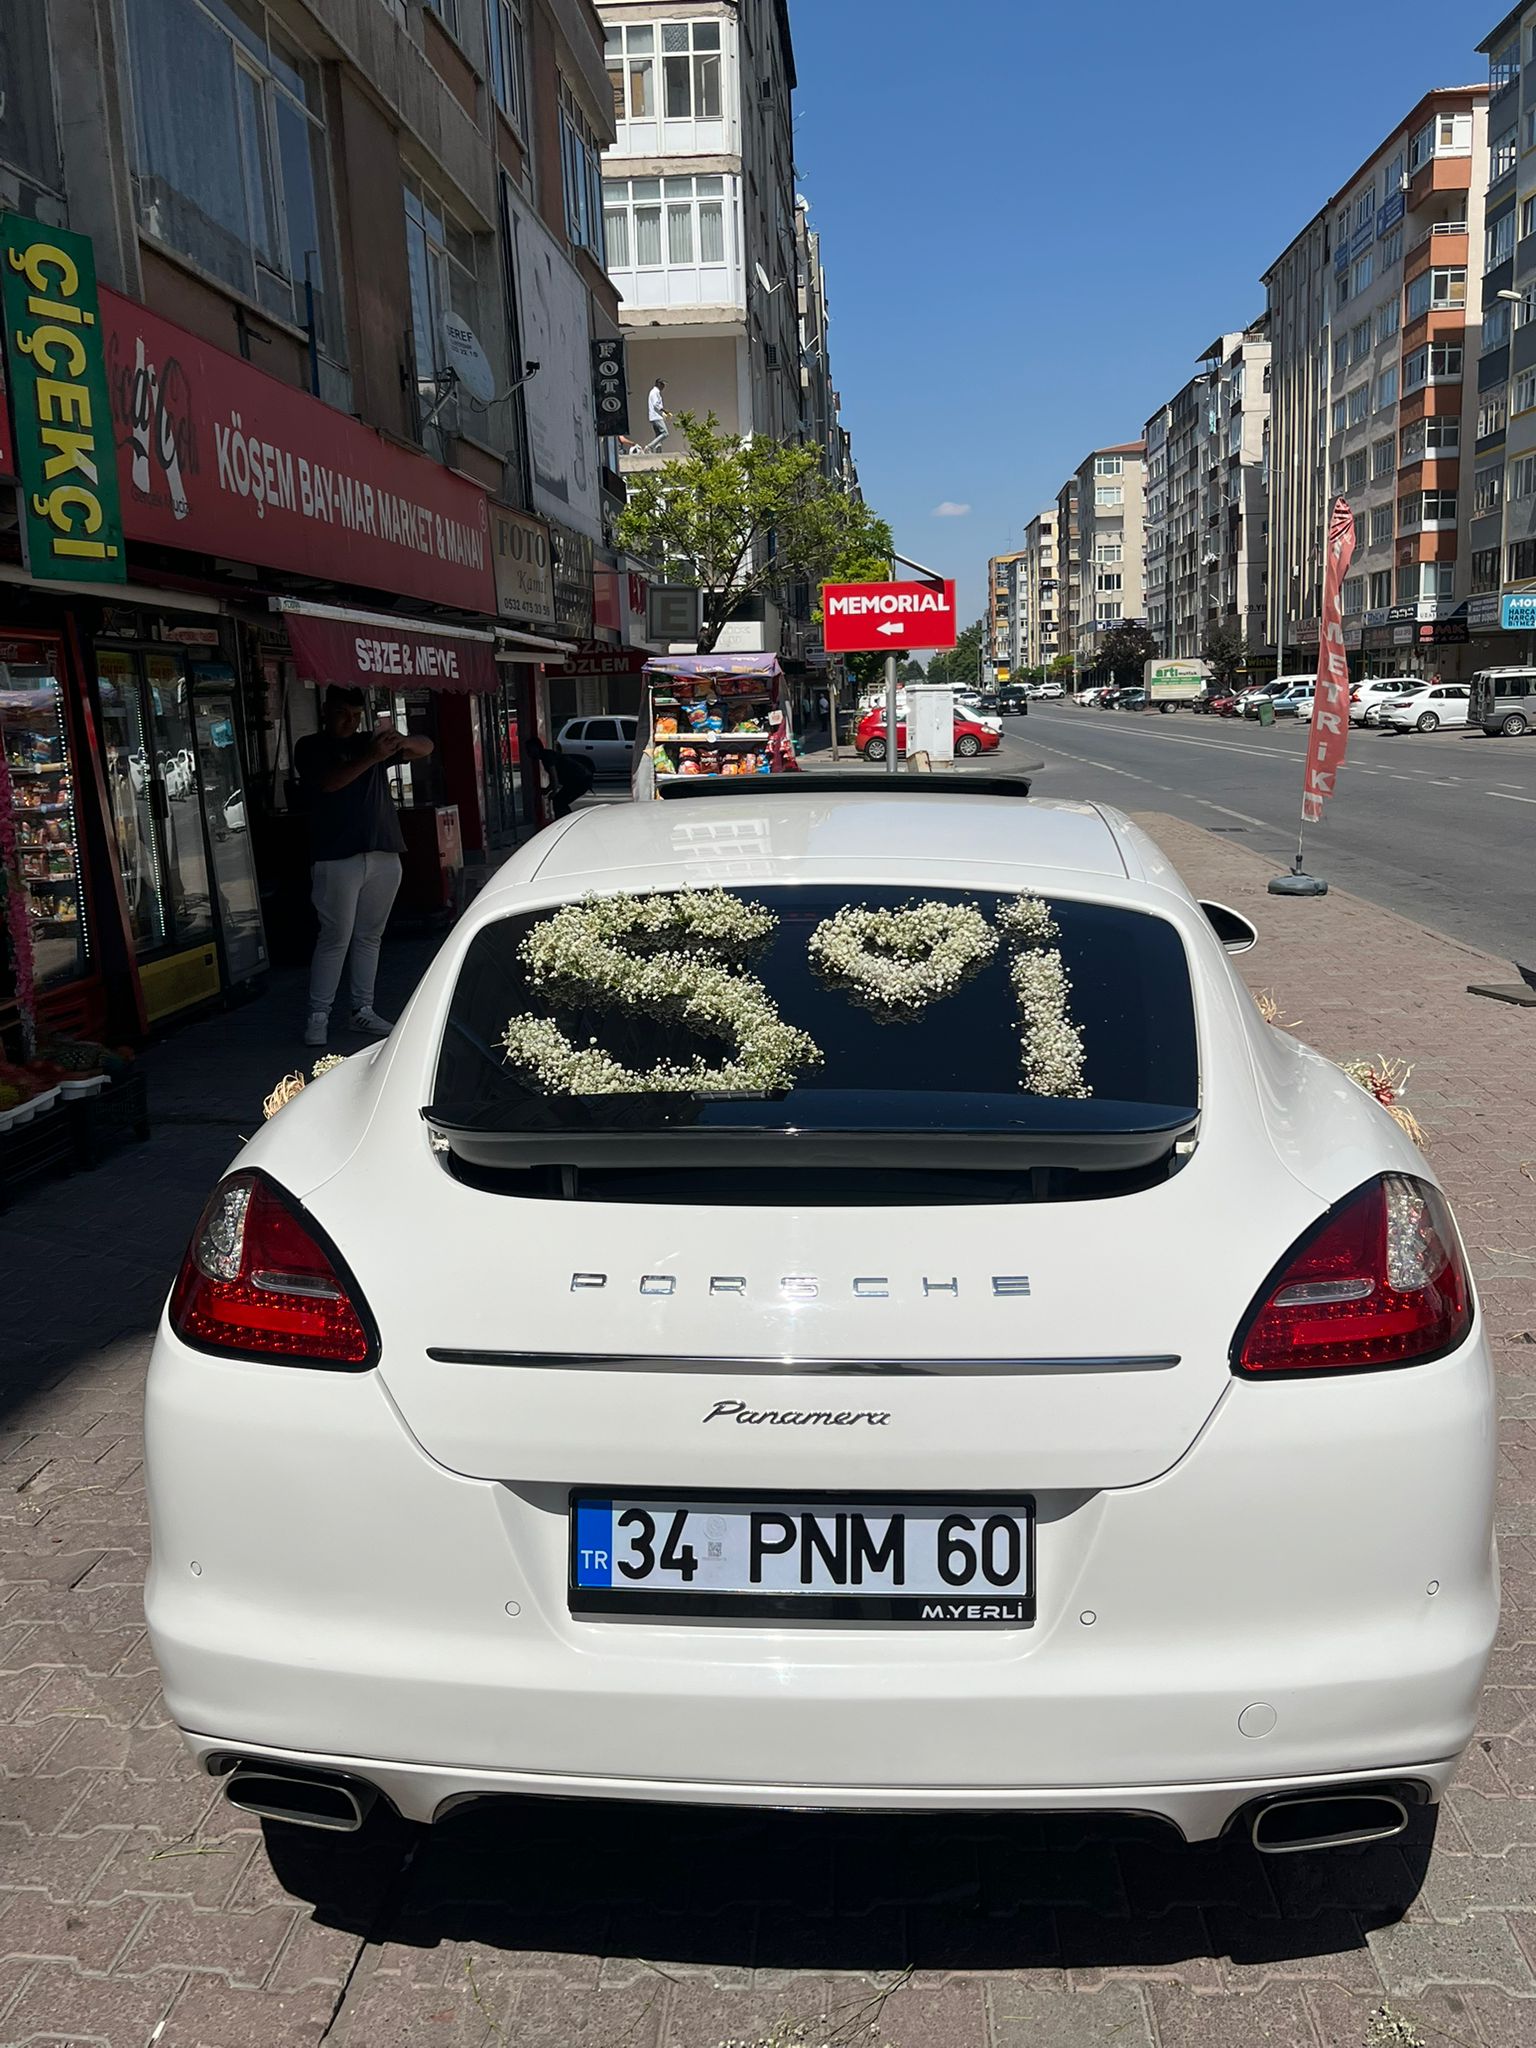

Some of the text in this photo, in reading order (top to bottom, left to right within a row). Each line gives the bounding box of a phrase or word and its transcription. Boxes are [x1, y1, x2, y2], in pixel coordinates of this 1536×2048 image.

[598, 342, 621, 413] FOTO
[9, 243, 118, 558] ÇİÇEKÇİ
[214, 410, 484, 571] KÖŞEM BAY-MAR MARKET & MANAV
[498, 519, 546, 568] FOTO
[661, 597, 689, 632] E
[829, 594, 950, 615] MEMORIAL
[355, 637, 459, 679] SEBZE & MEYVE
[562, 655, 630, 674] ÖZLEM
[569, 1272, 1031, 1297] PORSCHE
[702, 1399, 891, 1426] Panamera
[581, 1508, 1020, 1587] TR 34 PNM 60
[922, 1602, 1023, 1619] M.YERLİ
